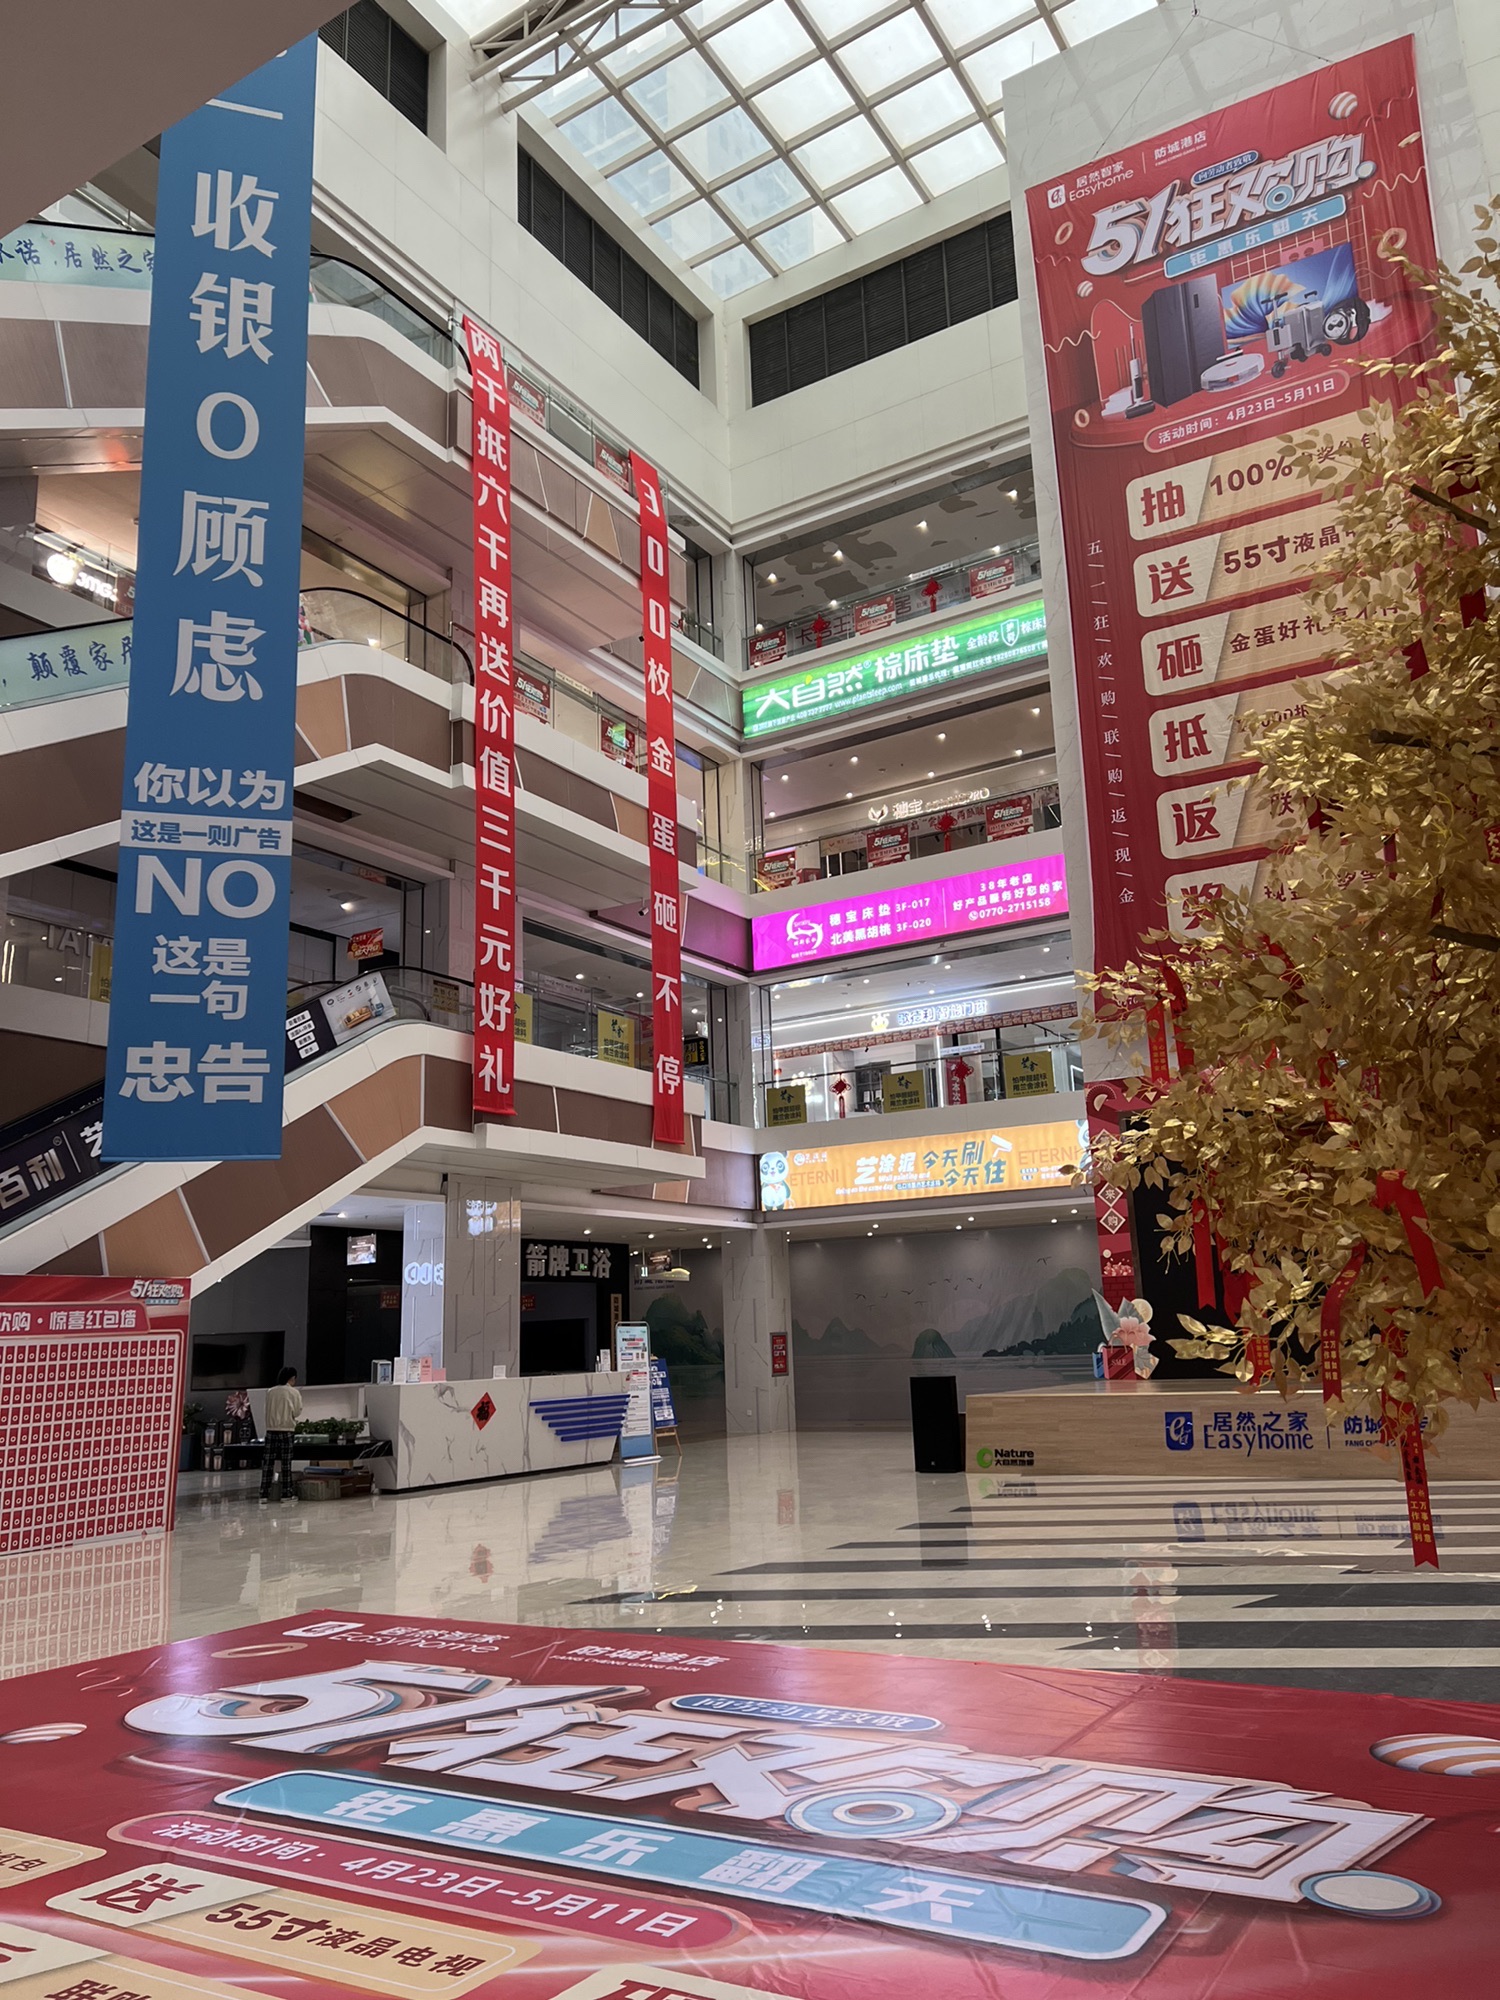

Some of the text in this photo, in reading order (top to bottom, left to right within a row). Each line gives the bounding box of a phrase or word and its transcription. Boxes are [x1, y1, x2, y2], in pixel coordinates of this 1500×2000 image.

[1154, 130, 1206, 160] 防城港店
[1069, 169, 1134, 202] Easyhome
[1076, 160, 1124, 188] 居然智家
[1082, 133, 1366, 277] 51狂欢购
[1141, 481, 1186, 528] 抽
[1149, 554, 1194, 604] 送
[1156, 633, 1203, 682] 砸
[755, 663, 863, 718] 大自然
[874, 636, 960, 683] 棕床垫
[1163, 714, 1212, 763] 抵
[134, 761, 286, 811] 你以为
[131, 819, 282, 851] 这是一则广告
[1171, 797, 1221, 846] 返
[135, 854, 276, 918] NO
[895, 897, 931, 912] 3F-017
[979, 897, 1051, 919] 0770-2715158
[152, 934, 251, 977] 这是
[150, 981, 248, 1021] 一句
[119, 1041, 270, 1103] 忠告
[923, 1140, 985, 1169] 今天刷
[790, 1169, 839, 1187] ETERNI
[944, 1160, 1007, 1187] 今天住
[526, 1242, 613, 1278] 箭牌卫浴
[130, 1280, 184, 1297] 51狂欢购
[1213, 1411, 1309, 1432] 居然之家
[994, 1448, 1034, 1458] Nature
[1203, 1424, 1314, 1457] Easyhome
[329, 1631, 500, 1654] Easyhome
[585, 1657, 627, 1665] CHENG
[629, 1660, 664, 1669] GANG
[666, 1664, 700, 1673] DIAN
[152, 1821, 326, 1863] 活动时间：
[79, 1873, 205, 1914] 送
[205, 1902, 488, 1979] 55寸液晶电视
